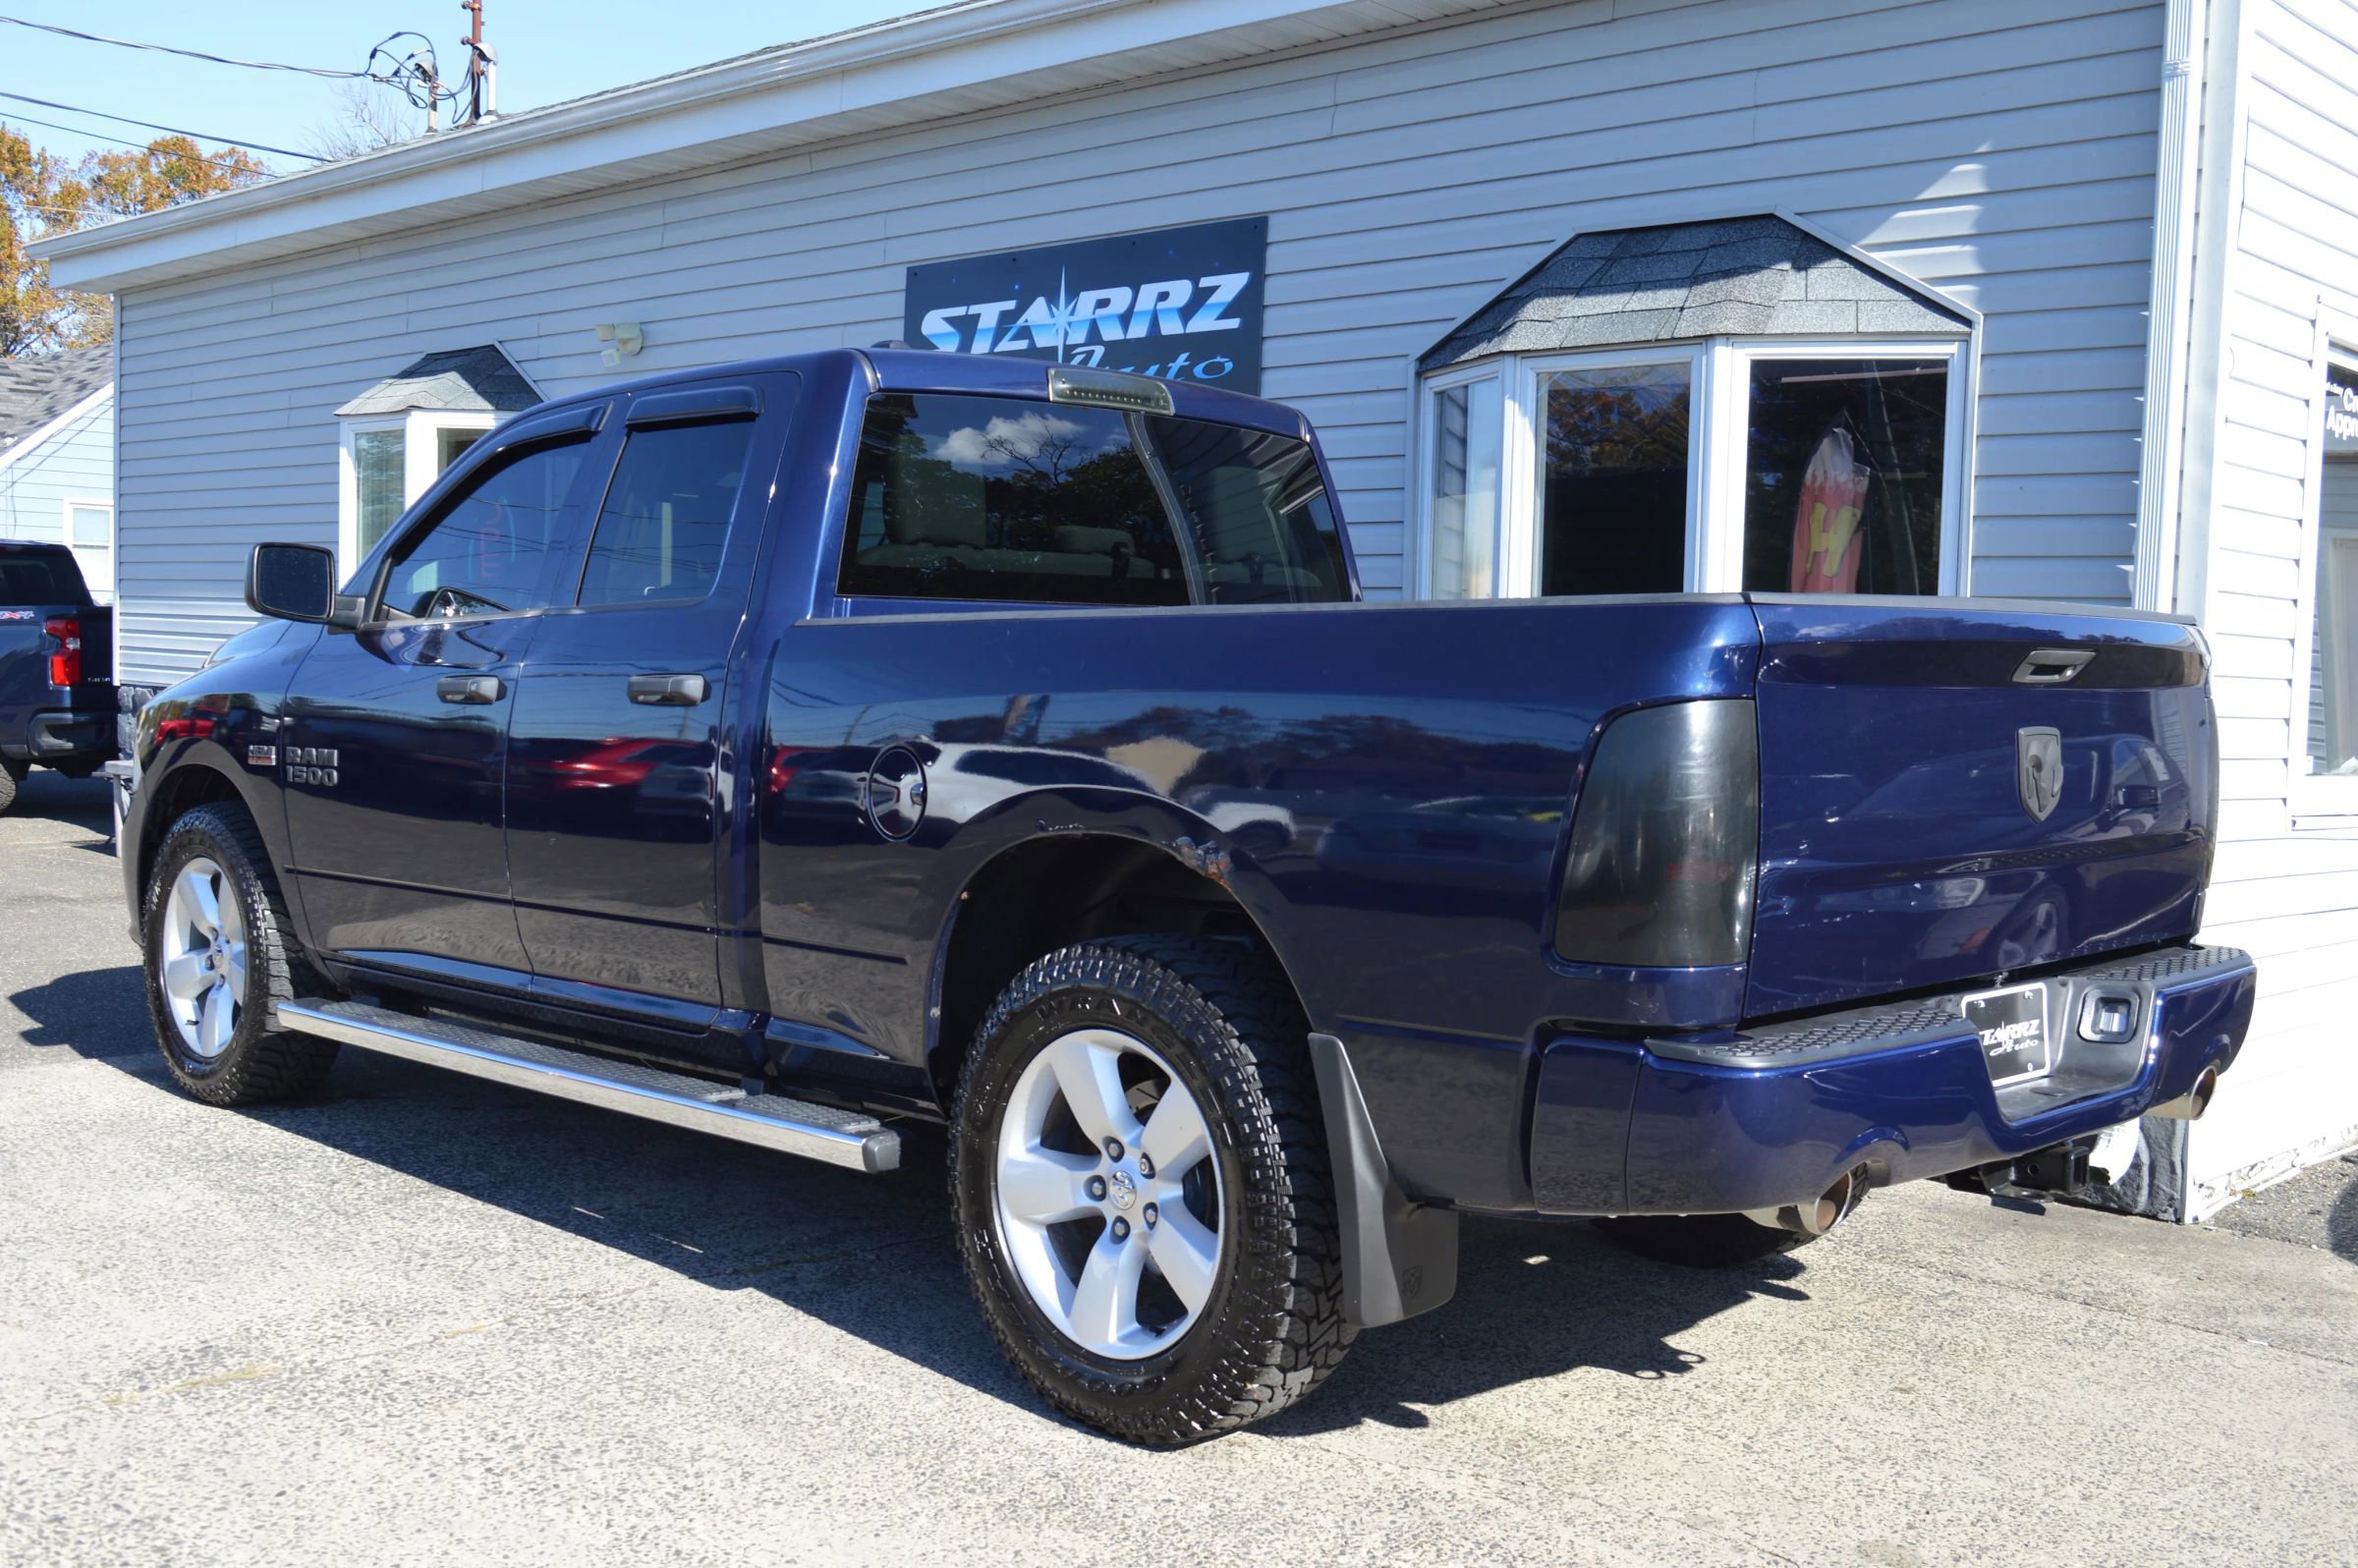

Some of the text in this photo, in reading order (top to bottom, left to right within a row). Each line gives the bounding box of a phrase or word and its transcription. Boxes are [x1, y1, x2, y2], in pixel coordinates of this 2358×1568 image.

[920, 271, 1251, 356] STARRZ
[286, 747, 338, 766] RAM
[286, 765, 338, 787] 1500
[1978, 1019, 2041, 1046] TARRZ
